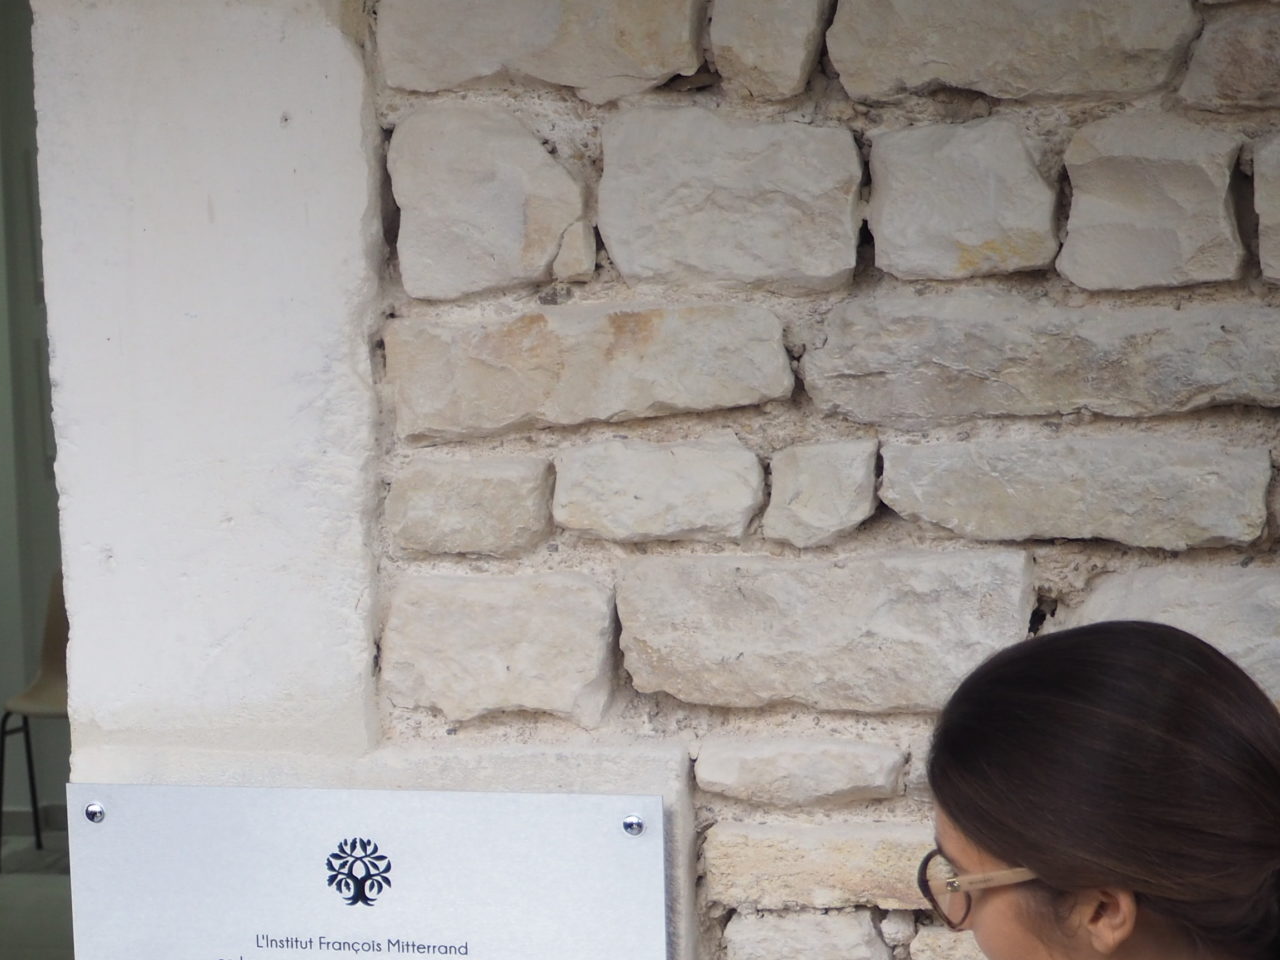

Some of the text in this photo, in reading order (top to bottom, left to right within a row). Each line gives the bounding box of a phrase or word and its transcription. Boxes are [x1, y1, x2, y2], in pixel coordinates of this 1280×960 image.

[255, 933, 469, 956] L'Institut François Mitterrand
